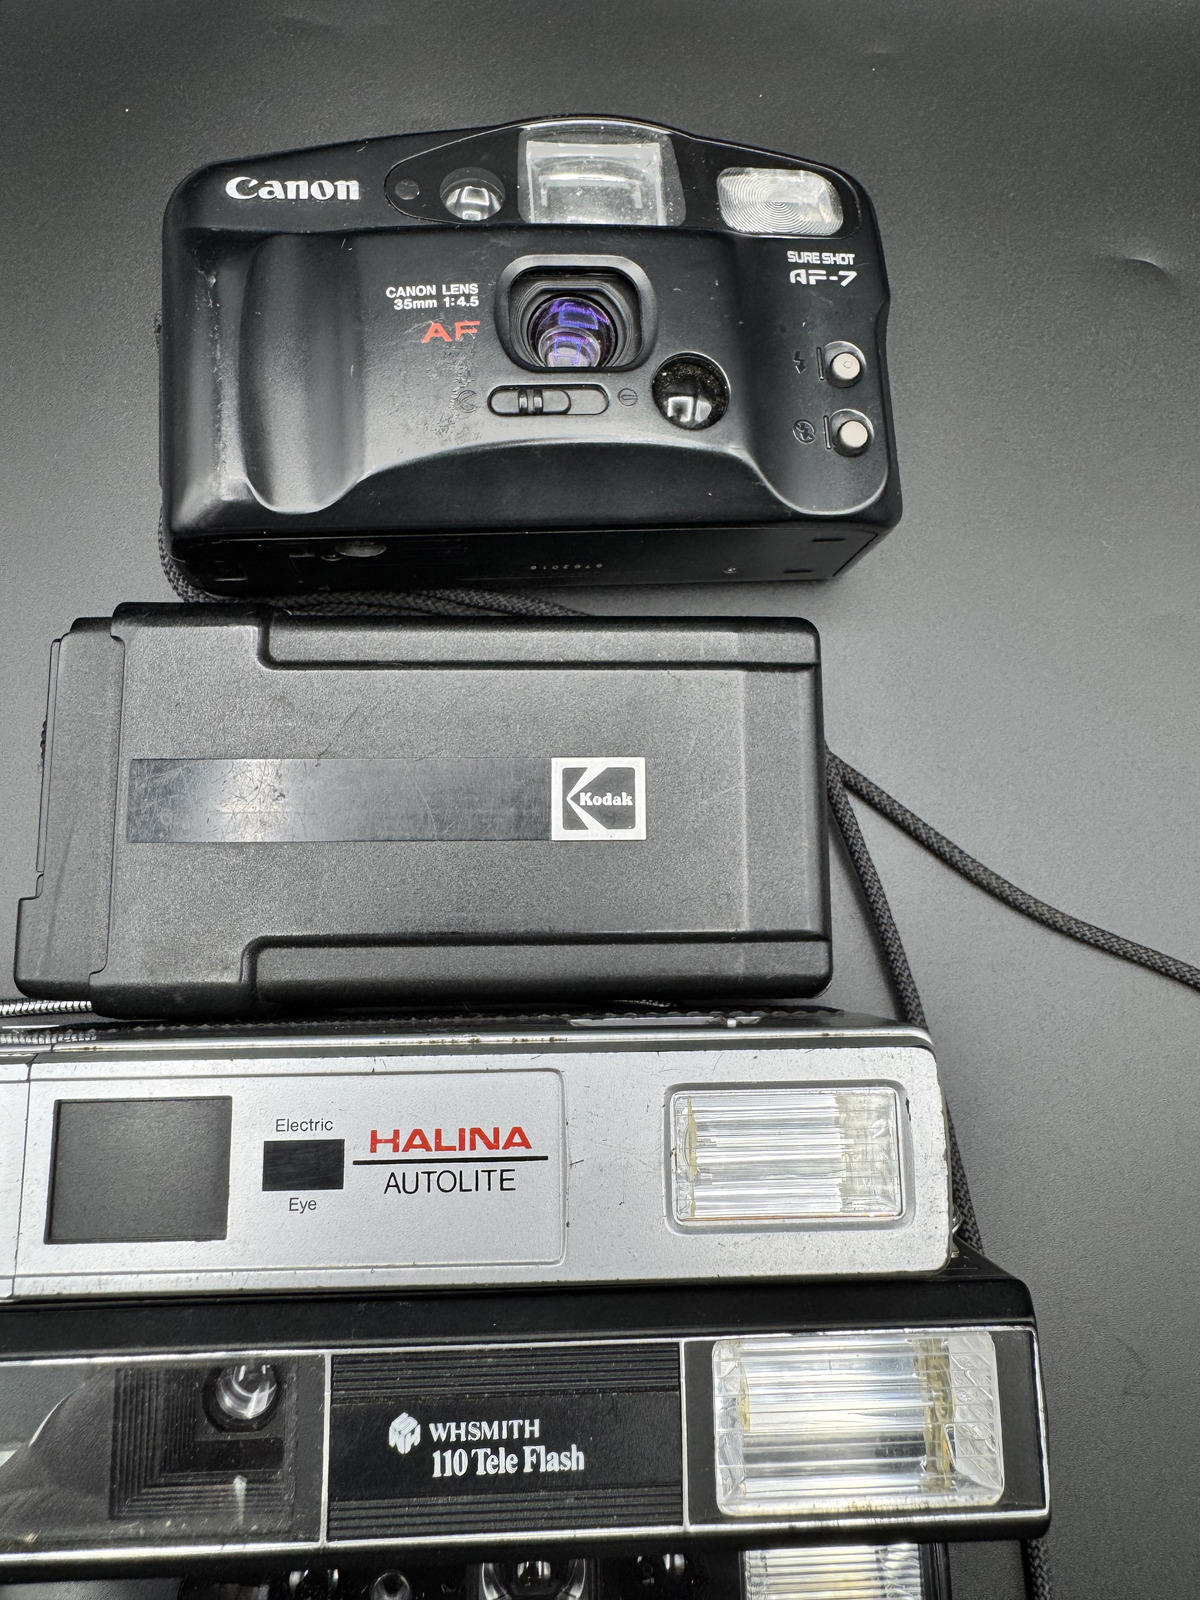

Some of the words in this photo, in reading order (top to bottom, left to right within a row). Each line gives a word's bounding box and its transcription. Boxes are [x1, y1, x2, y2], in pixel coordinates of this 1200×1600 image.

[225, 176, 361, 202] Canon
[787, 250, 821, 264] SURE
[821, 252, 855, 266] SHOT
[789, 268, 858, 287] AF-7
[385, 285, 437, 299] CANON
[441, 283, 479, 296] LENS
[393, 298, 438, 310] 35mm
[443, 296, 479, 308] 1:4.5
[421, 320, 481, 344] AF
[579, 791, 633, 806] Kodak
[275, 1118, 334, 1132] Electric
[369, 1126, 532, 1153] HALINA
[383, 1169, 516, 1194] AUTOLITE
[288, 1197, 317, 1214] Eye
[428, 1418, 540, 1442] WHSMITH
[432, 1448, 469, 1478] 110
[471, 1446, 519, 1476] Tele
[522, 1443, 585, 1473] Flash
